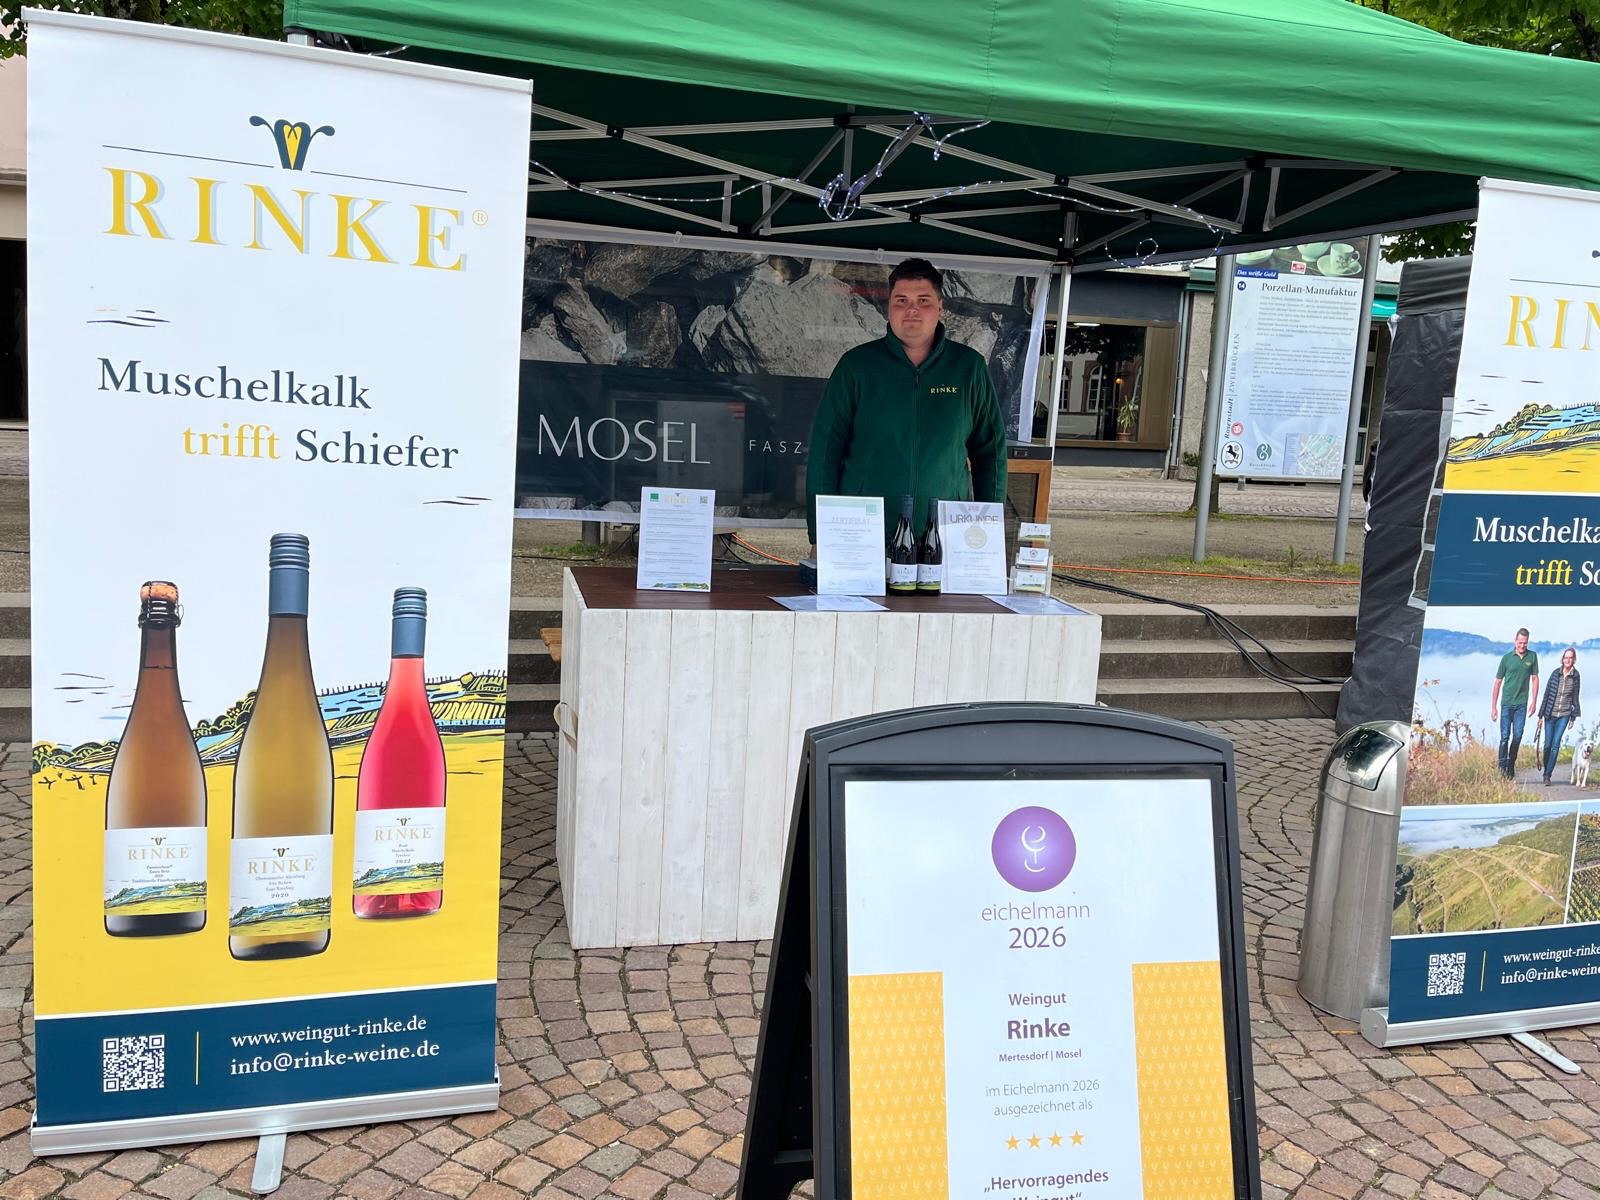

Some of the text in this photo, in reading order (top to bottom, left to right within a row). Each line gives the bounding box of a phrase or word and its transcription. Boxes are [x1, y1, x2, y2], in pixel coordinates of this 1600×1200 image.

[1261, 282, 1358, 297] Porzellan-Manufaktur
[1502, 295, 1600, 351] RIN
[97, 357, 372, 410] Muschelkalk
[1224, 398, 1233, 440] Rosenstadt
[182, 422, 459, 469] trifft Schiefer
[538, 414, 803, 464] MOSEL FASZ
[1472, 516, 1600, 544] Muschelka
[1516, 559, 1573, 586] trifft
[375, 827, 432, 841] RINKE
[128, 847, 189, 861] RINKE
[247, 857, 314, 874] RINKE
[981, 901, 1090, 921] eichelmann
[1009, 926, 1066, 949] 2026
[1503, 943, 1600, 963] www.weingut-rinke
[1501, 963, 1600, 984] info@rinke-wein
[1008, 992, 1067, 1008] Weingut
[231, 1015, 427, 1048] www.weingut-rinke.de
[1007, 1018, 1071, 1040] Rinke
[230, 1040, 440, 1075] info@rinke-weine.de
[999, 1048, 1082, 1062] Mertesdorf Mosel
[985, 1079, 1100, 1097] im Eichelmann 2026
[994, 1098, 1093, 1118] ausgezeichnet als
[984, 1169, 1109, 1193] „Hervorragendes
